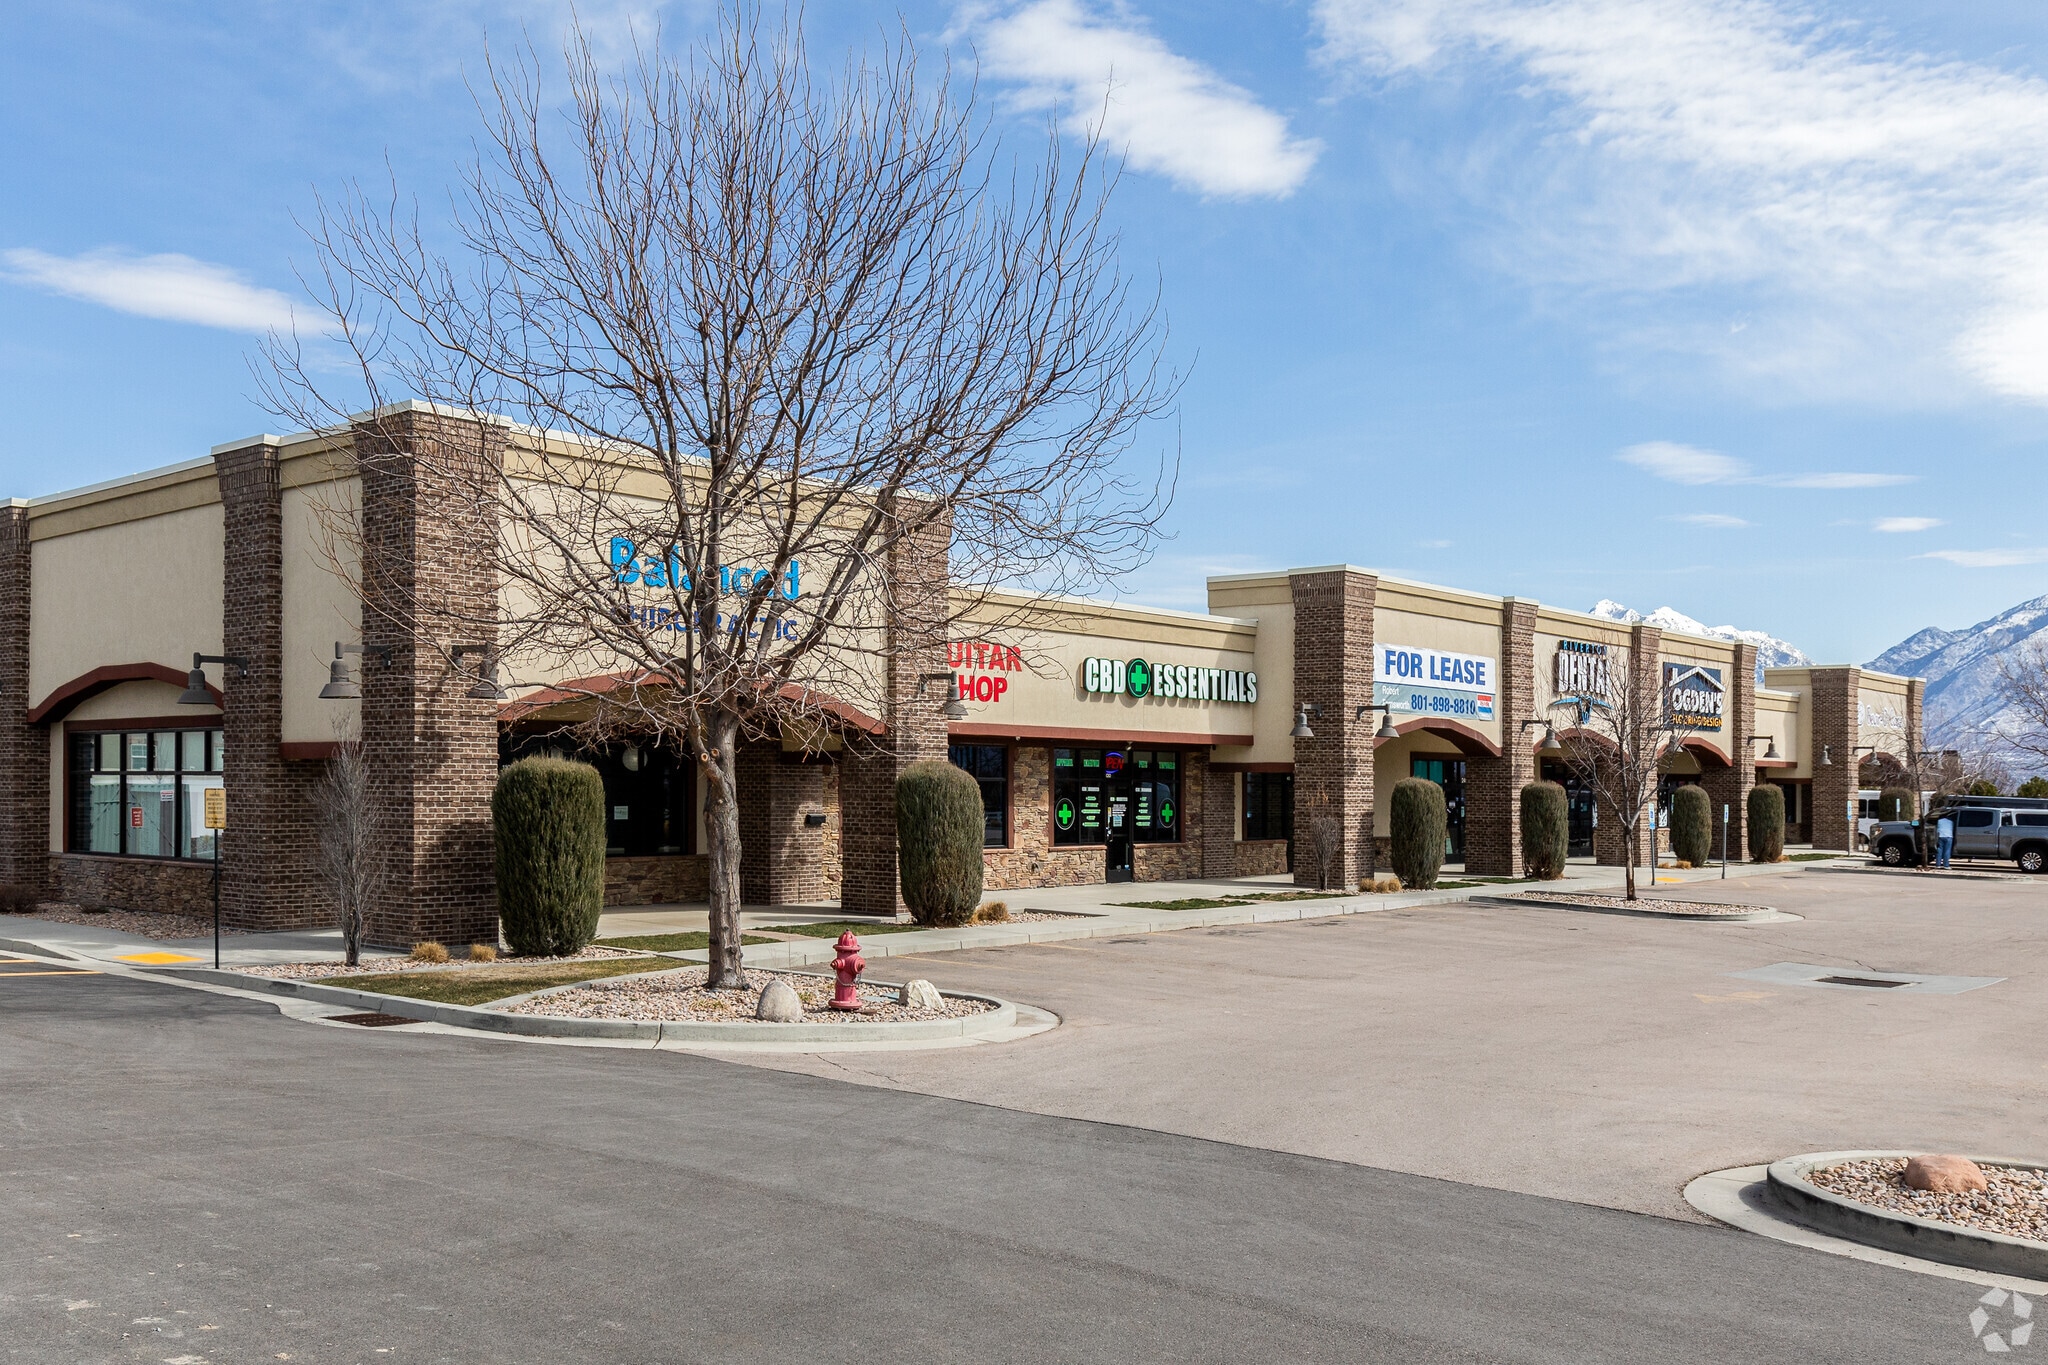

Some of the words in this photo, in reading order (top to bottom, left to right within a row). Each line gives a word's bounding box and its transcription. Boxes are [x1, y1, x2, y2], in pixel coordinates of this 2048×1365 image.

[610, 536, 799, 601] Balcd
[947, 641, 1023, 672] UITAR
[1385, 649, 1424, 679] FOR
[1430, 655, 1486, 686] LEASE
[958, 674, 1009, 702] HOP
[1084, 657, 1126, 694] CBD
[1152, 662, 1258, 704] ESSENTIALS
[1411, 693, 1477, 715] 801-898-8810
[1672, 687, 1722, 715] OGDEN'S
[1105, 756, 1125, 770] PEN
